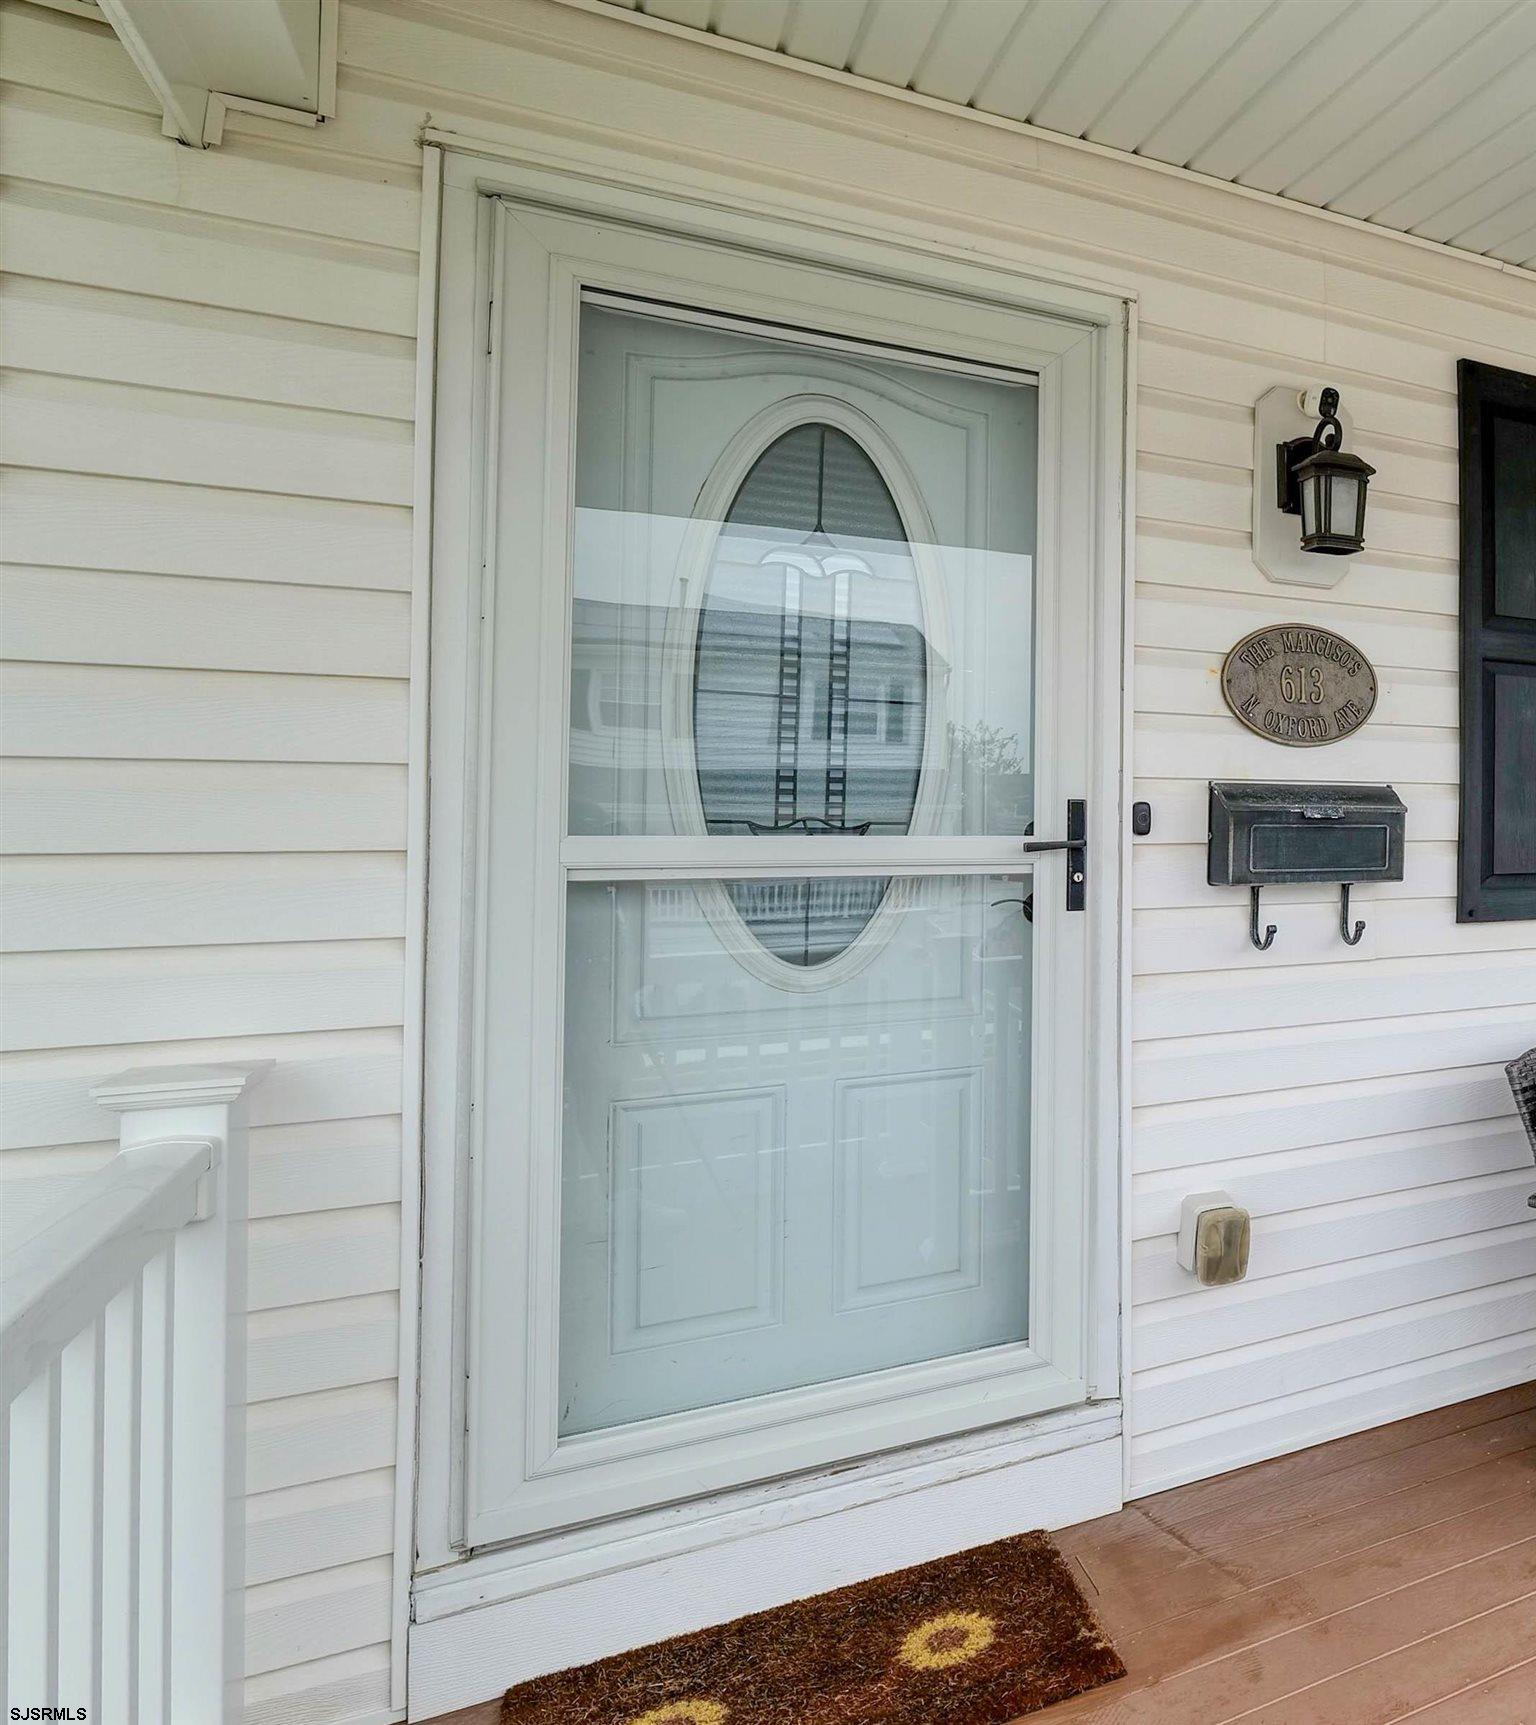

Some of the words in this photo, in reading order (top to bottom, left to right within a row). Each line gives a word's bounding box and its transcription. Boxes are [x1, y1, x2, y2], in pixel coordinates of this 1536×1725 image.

[1240, 638, 1275, 669] THE
[1281, 632, 1363, 677] MANCUSO'S
[1280, 664, 1325, 704] 613
[1241, 694, 1260, 717] N.
[1264, 709, 1329, 738] OXFORD
[1334, 701, 1366, 731] AVE.
